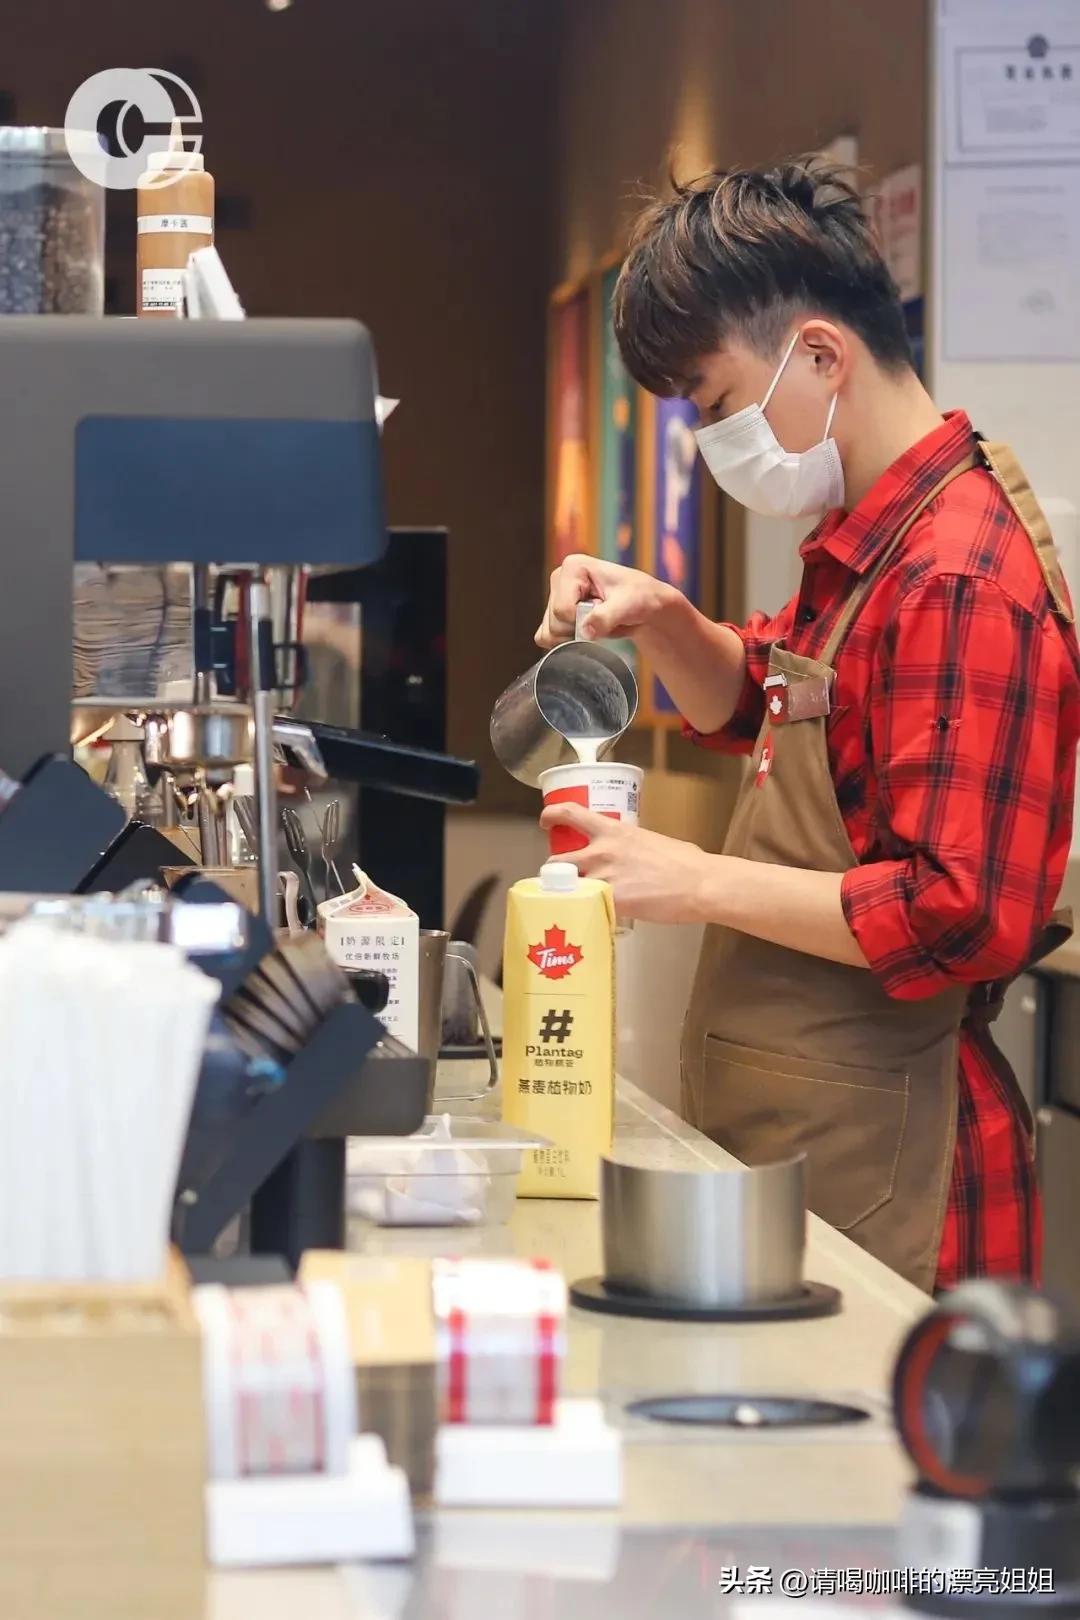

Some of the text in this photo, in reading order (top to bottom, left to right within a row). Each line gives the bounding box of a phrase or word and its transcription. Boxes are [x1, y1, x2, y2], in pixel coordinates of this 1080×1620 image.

[536, 947, 575, 969] Tims
[525, 1045, 583, 1059] Plantag
[518, 1078, 592, 1096] 燕麦植物奶
